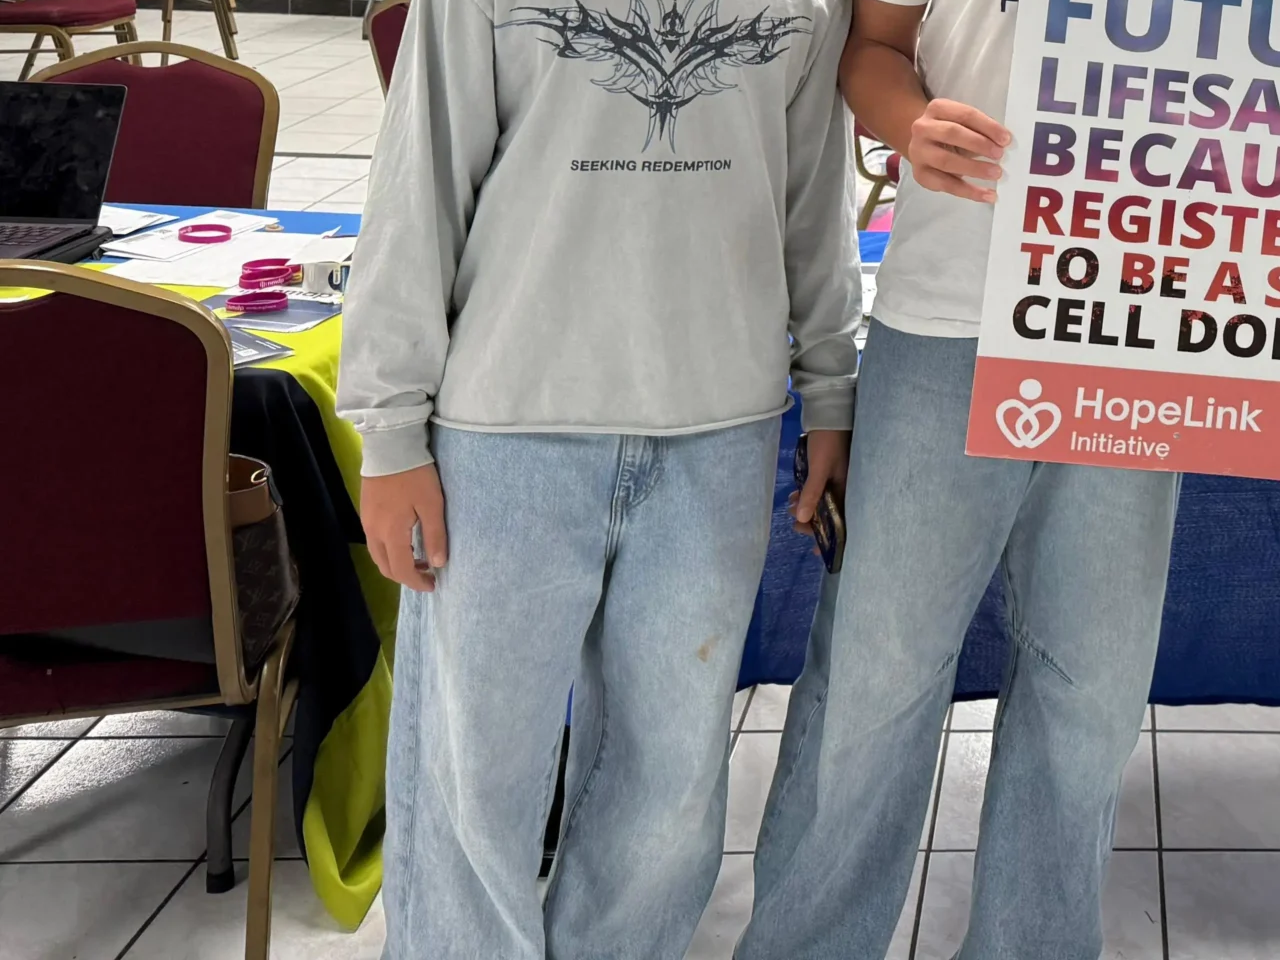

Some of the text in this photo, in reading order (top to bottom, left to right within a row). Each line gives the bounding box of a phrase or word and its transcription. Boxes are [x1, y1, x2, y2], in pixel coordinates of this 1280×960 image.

[570, 159, 732, 172] SEEKING REDEMPTION
[1021, 243, 1099, 289] TO
[1119, 252, 1190, 299] BE
[1204, 262, 1246, 304] A
[1013, 295, 1155, 349] CELL
[1074, 387, 1263, 432] HopeLink
[1070, 431, 1170, 457] Initiative
